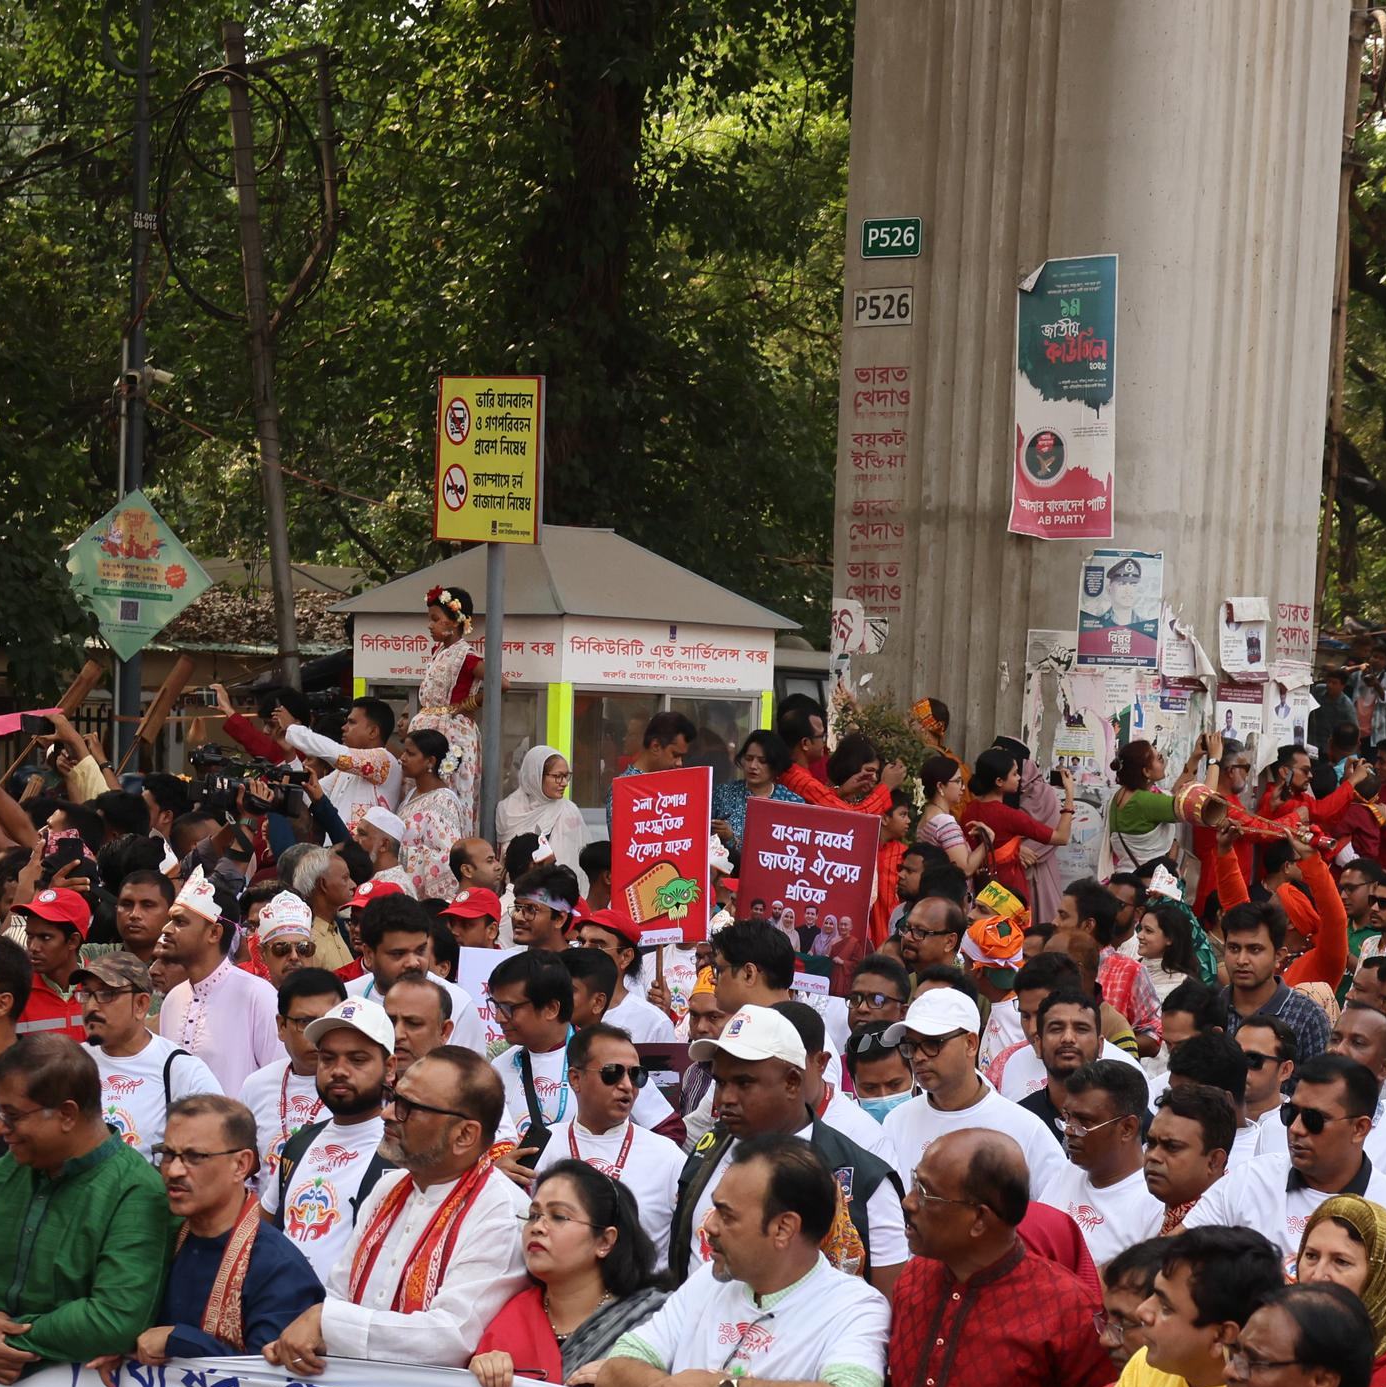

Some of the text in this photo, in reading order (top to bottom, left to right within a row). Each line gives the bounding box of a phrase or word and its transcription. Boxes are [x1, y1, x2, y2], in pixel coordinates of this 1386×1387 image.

[867, 226, 915, 248] P526
[855, 293, 910, 321] P526
[1041, 318, 1080, 339] জাতীয়
[854, 366, 910, 385] ভারত
[475, 389, 533, 409] ভারি যানবাহন
[854, 388, 910, 410] খেদাও
[475, 412, 531, 433] ও গণপরিবহন
[474, 436, 526, 456] প্রবেশ নিষেধ
[851, 428, 907, 447] বয়কট
[851, 450, 906, 470] ইন্ডিয়া
[473, 471, 524, 489] ক্যাম্পাসে হর্ন
[472, 492, 531, 511] বাজানো নিষেধ
[1018, 496, 1107, 513] আমার বাংলাদেশ পার্টি
[1038, 515, 1086, 525] AB PARTY
[850, 522, 904, 540] খেদাও
[847, 561, 901, 580] ভারত
[360, 634, 429, 652] সিকিউরিটি
[529, 641, 555, 657] বক্স
[570, 635, 769, 665] সিকিউরিটি এন্ড সার্ভিলেন্স বক্স
[636, 658, 708, 672] ঢাকা বিশ্ববিদ্যালয়
[632, 791, 687, 814] ১লা বৈশাখ
[772, 823, 854, 851] বাংলা নববর্ষ
[626, 838, 693, 863] ঐক্যের বাহক
[758, 845, 861, 885] জাতীয় ঐক্যের
[785, 879, 828, 905] প্রতিক
